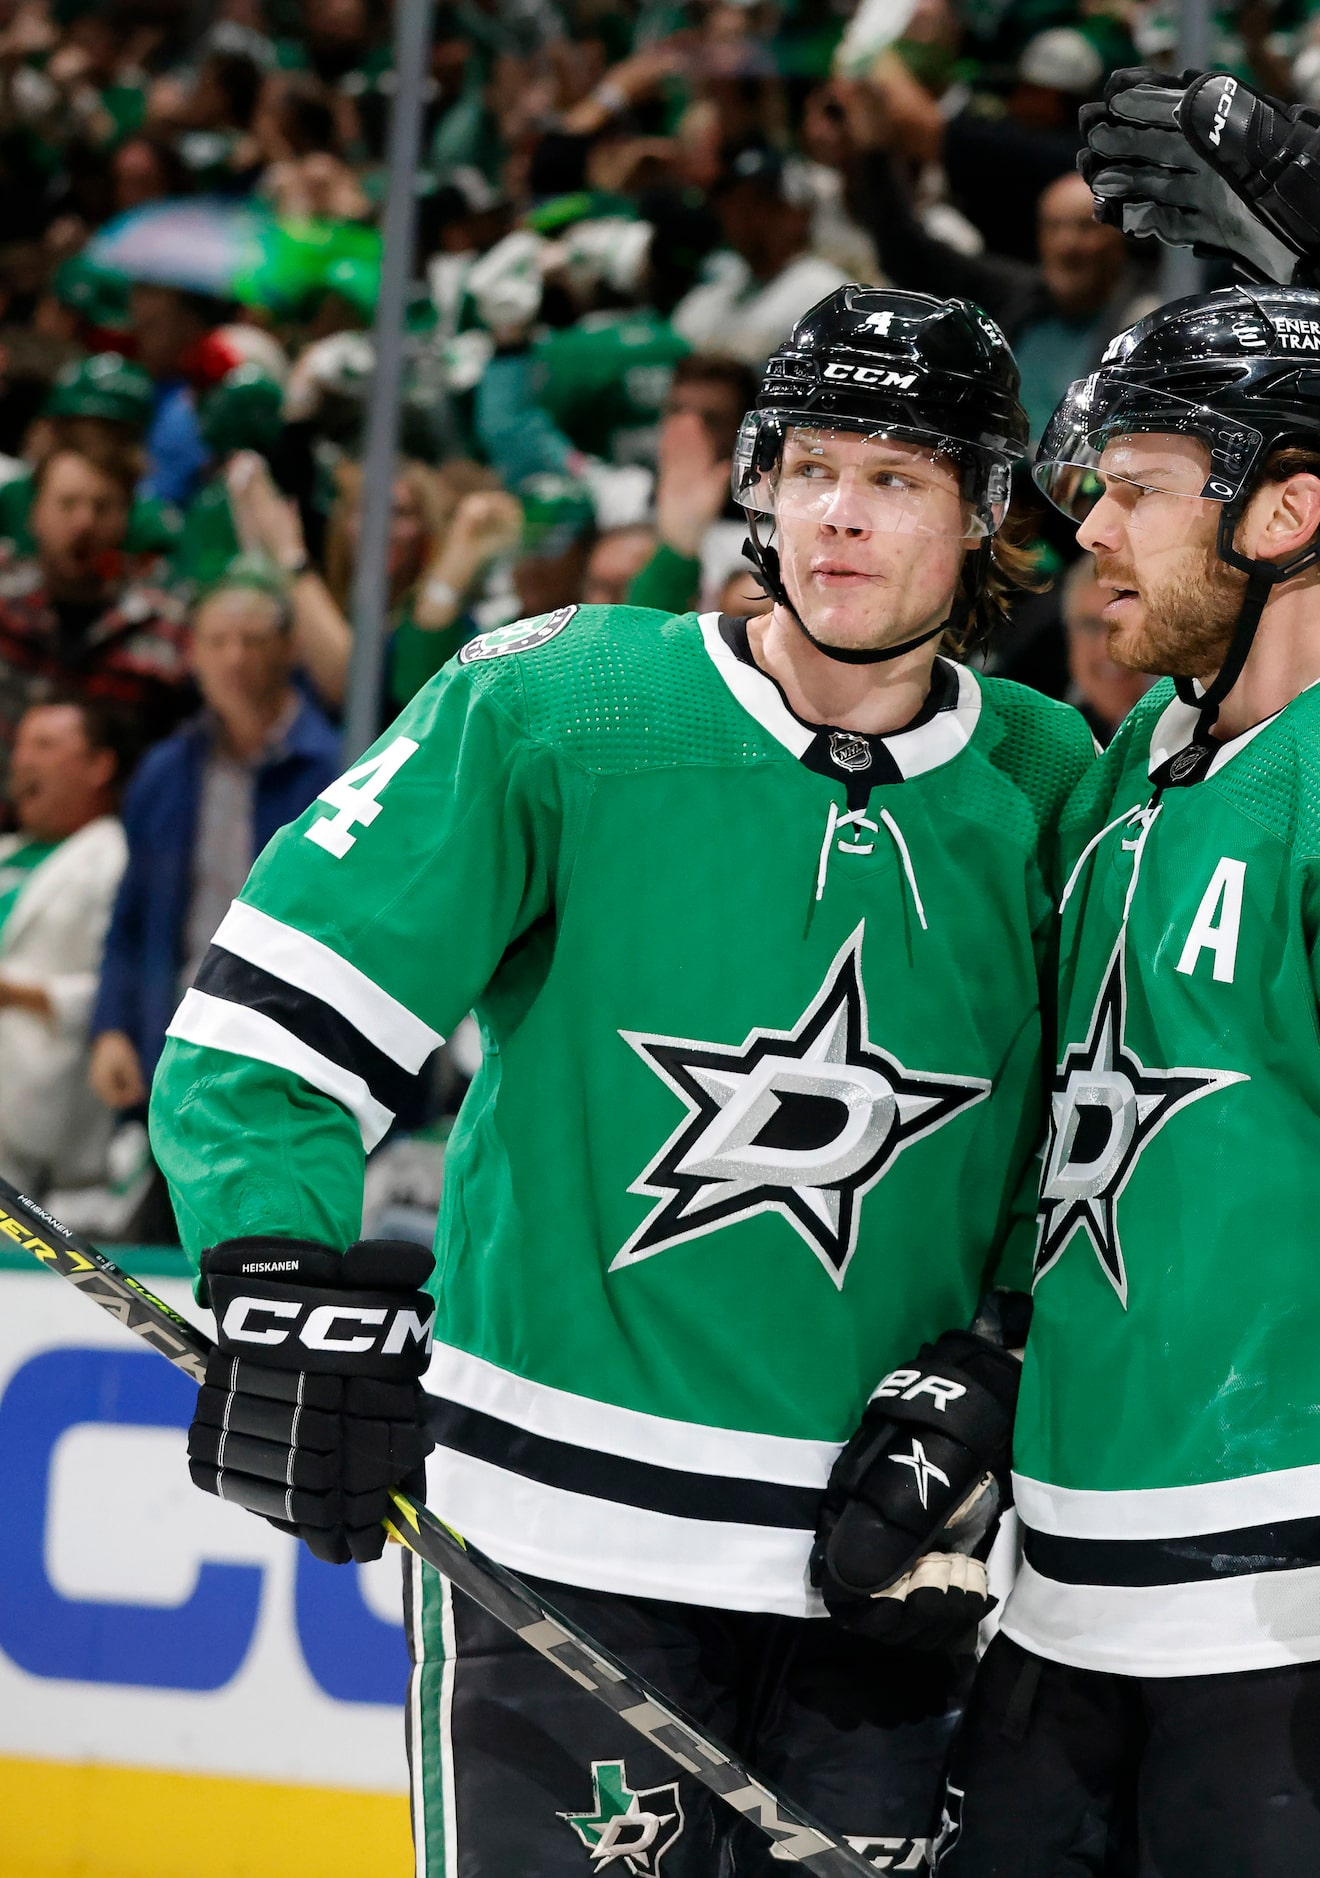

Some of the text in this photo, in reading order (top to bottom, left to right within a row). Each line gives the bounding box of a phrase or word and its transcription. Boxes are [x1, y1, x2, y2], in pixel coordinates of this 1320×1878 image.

[1208, 77, 1238, 147] CCM
[865, 311, 895, 335] 4
[823, 362, 920, 389] CCM
[303, 735, 420, 859] 4
[1175, 857, 1247, 984] A
[0, 1208, 58, 1262] ER
[17, 1194, 73, 1238] HEISKANEN
[242, 1260, 299, 1273] HEISKANEN
[222, 1296, 436, 1355] CCM
[517, 1610, 838, 1860] CCM
